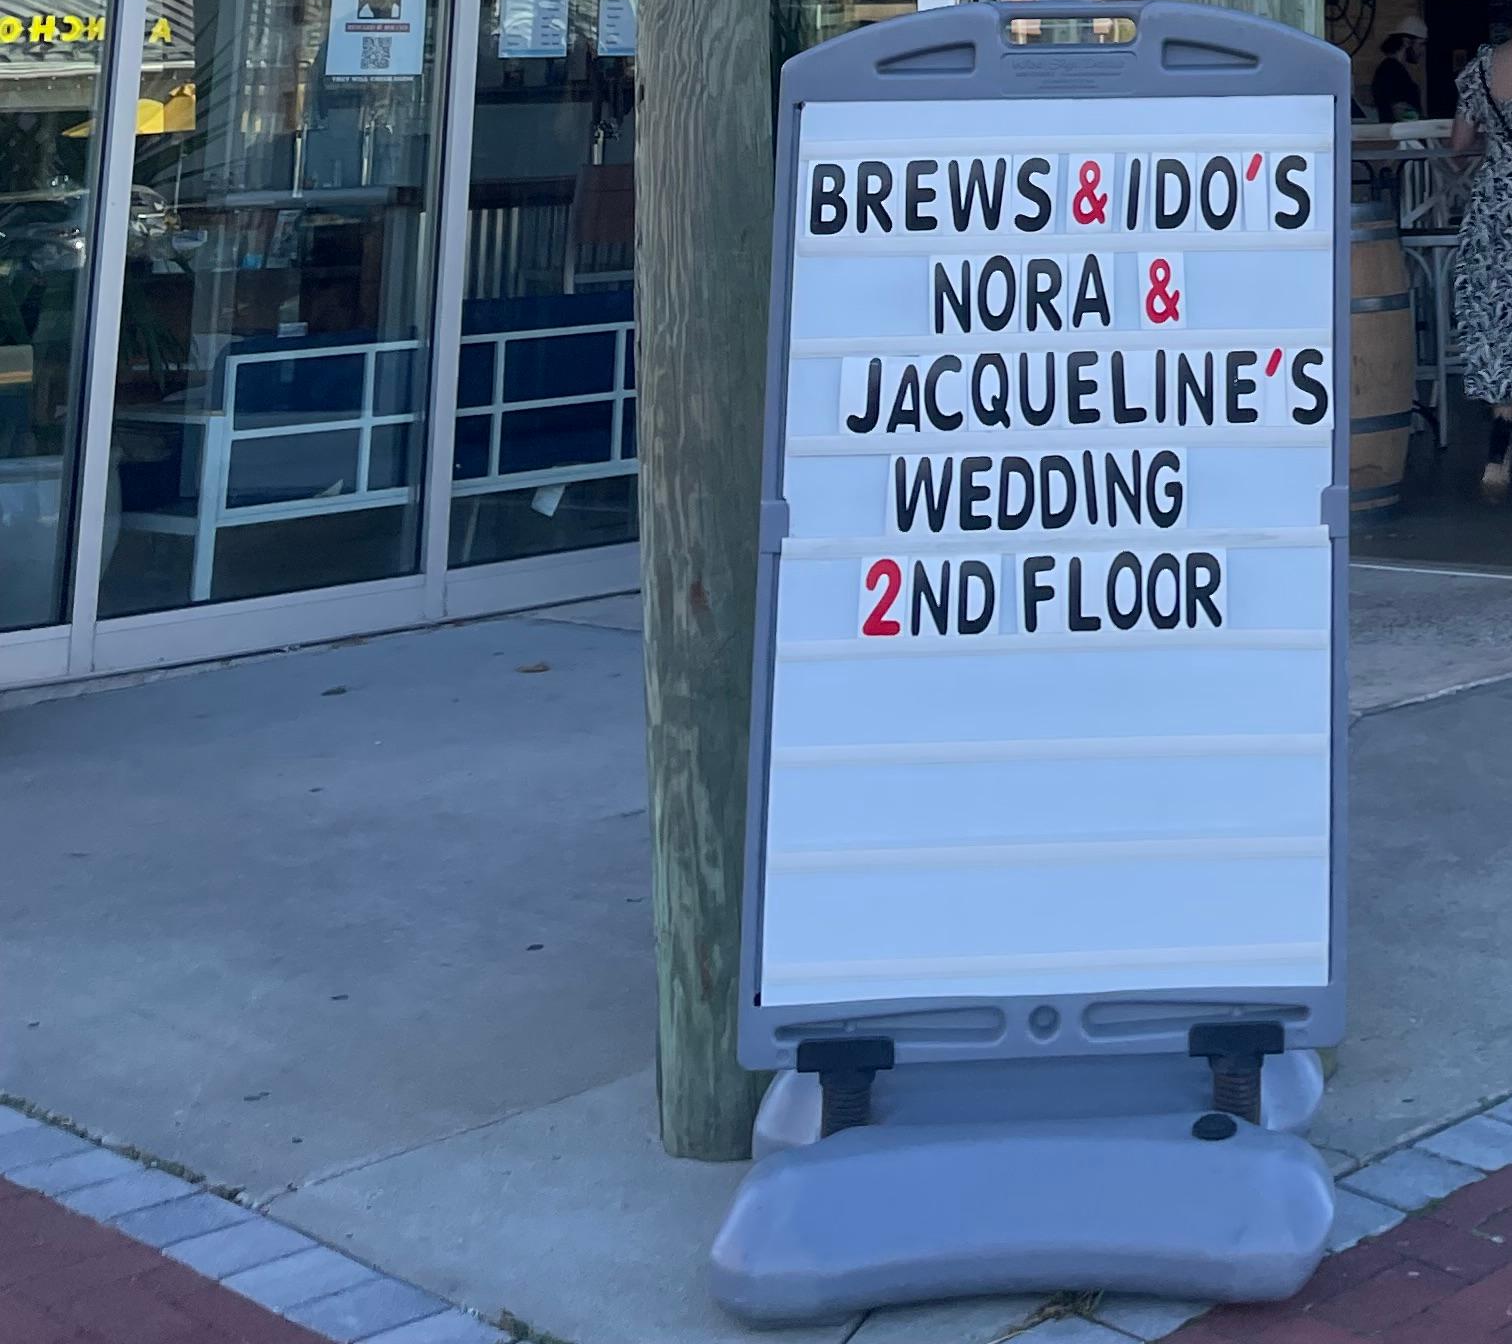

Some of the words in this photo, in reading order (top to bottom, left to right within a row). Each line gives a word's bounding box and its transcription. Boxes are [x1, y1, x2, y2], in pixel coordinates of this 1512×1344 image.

[809, 158, 1053, 235] BREWS
[1072, 160, 1108, 225] &
[1126, 153, 1311, 231] IDO'S
[933, 254, 1111, 335] NORA
[1145, 258, 1180, 325] &
[846, 348, 1329, 434] JACQUELINE'S
[894, 449, 1184, 533] WEDDING
[861, 558, 995, 637] 2ND
[1023, 550, 1223, 633] FLOOR
